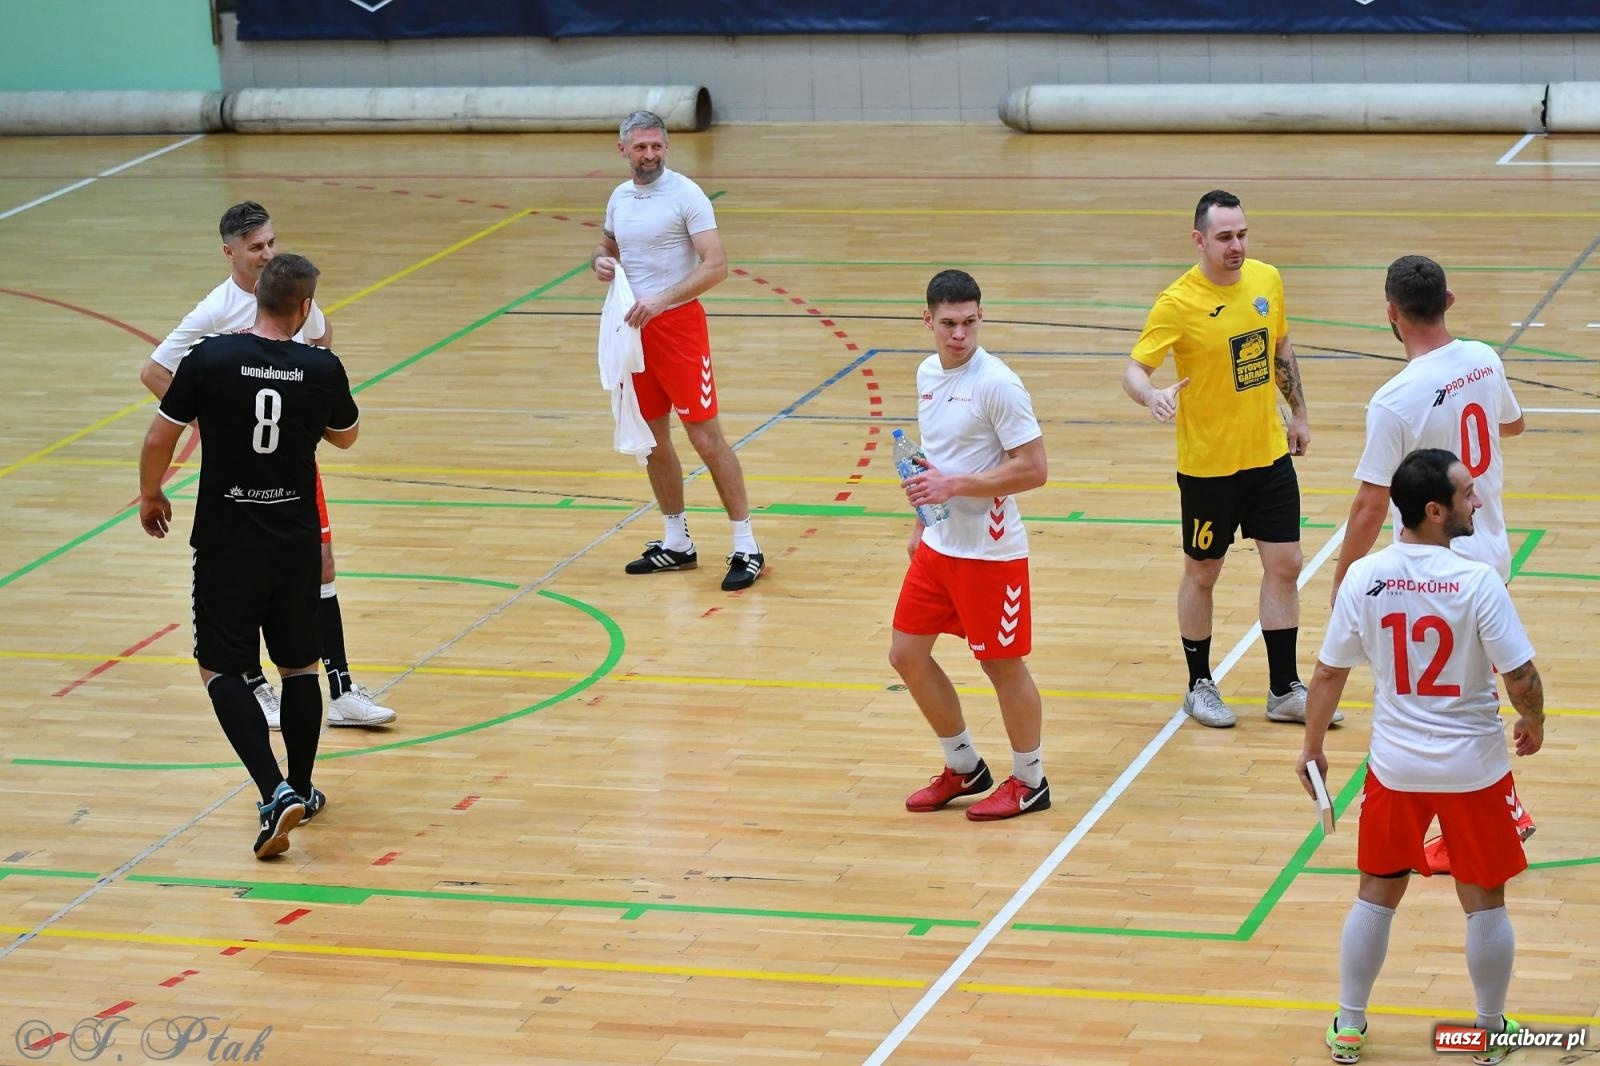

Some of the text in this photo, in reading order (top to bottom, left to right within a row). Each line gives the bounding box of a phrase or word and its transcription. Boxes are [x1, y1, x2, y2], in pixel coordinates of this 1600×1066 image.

[240, 365, 304, 382] woniakowski
[1445, 365, 1494, 394] PRD KÜHN
[252, 388, 282, 454] 8
[1460, 402, 1492, 478] 0
[1192, 518, 1214, 550] 16
[1386, 579, 1460, 593] PRD KÜHN
[1381, 612, 1461, 697] 12
